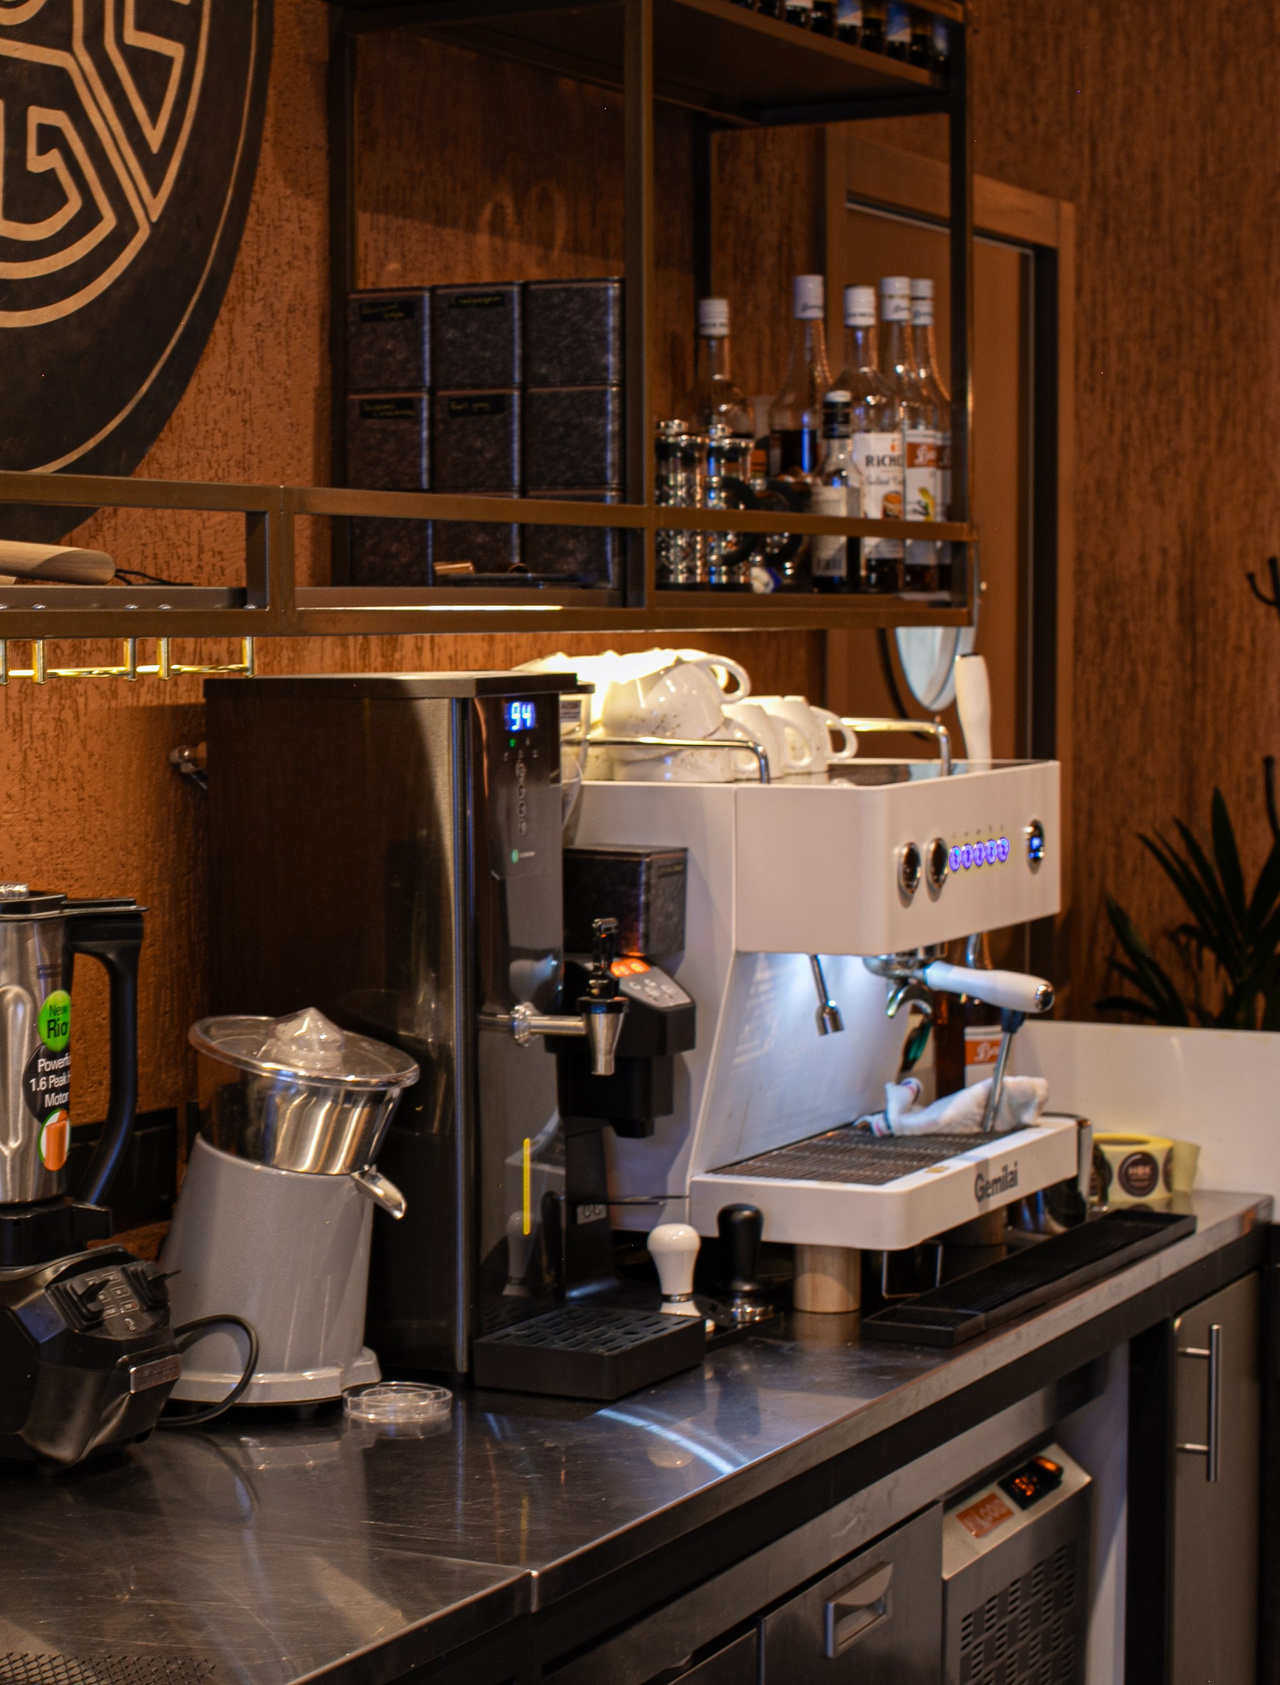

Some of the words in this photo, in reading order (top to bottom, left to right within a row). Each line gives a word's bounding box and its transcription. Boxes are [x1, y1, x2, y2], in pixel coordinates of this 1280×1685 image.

[511, 701, 533, 732] 94
[49, 1004, 69, 1018] New
[37, 1053, 72, 1074] Powerfu
[29, 1077, 48, 1093] 1.6
[48, 1072, 68, 1090] Peak
[44, 1092, 70, 1109] Motor
[974, 1160, 1018, 1203] Gemilai
